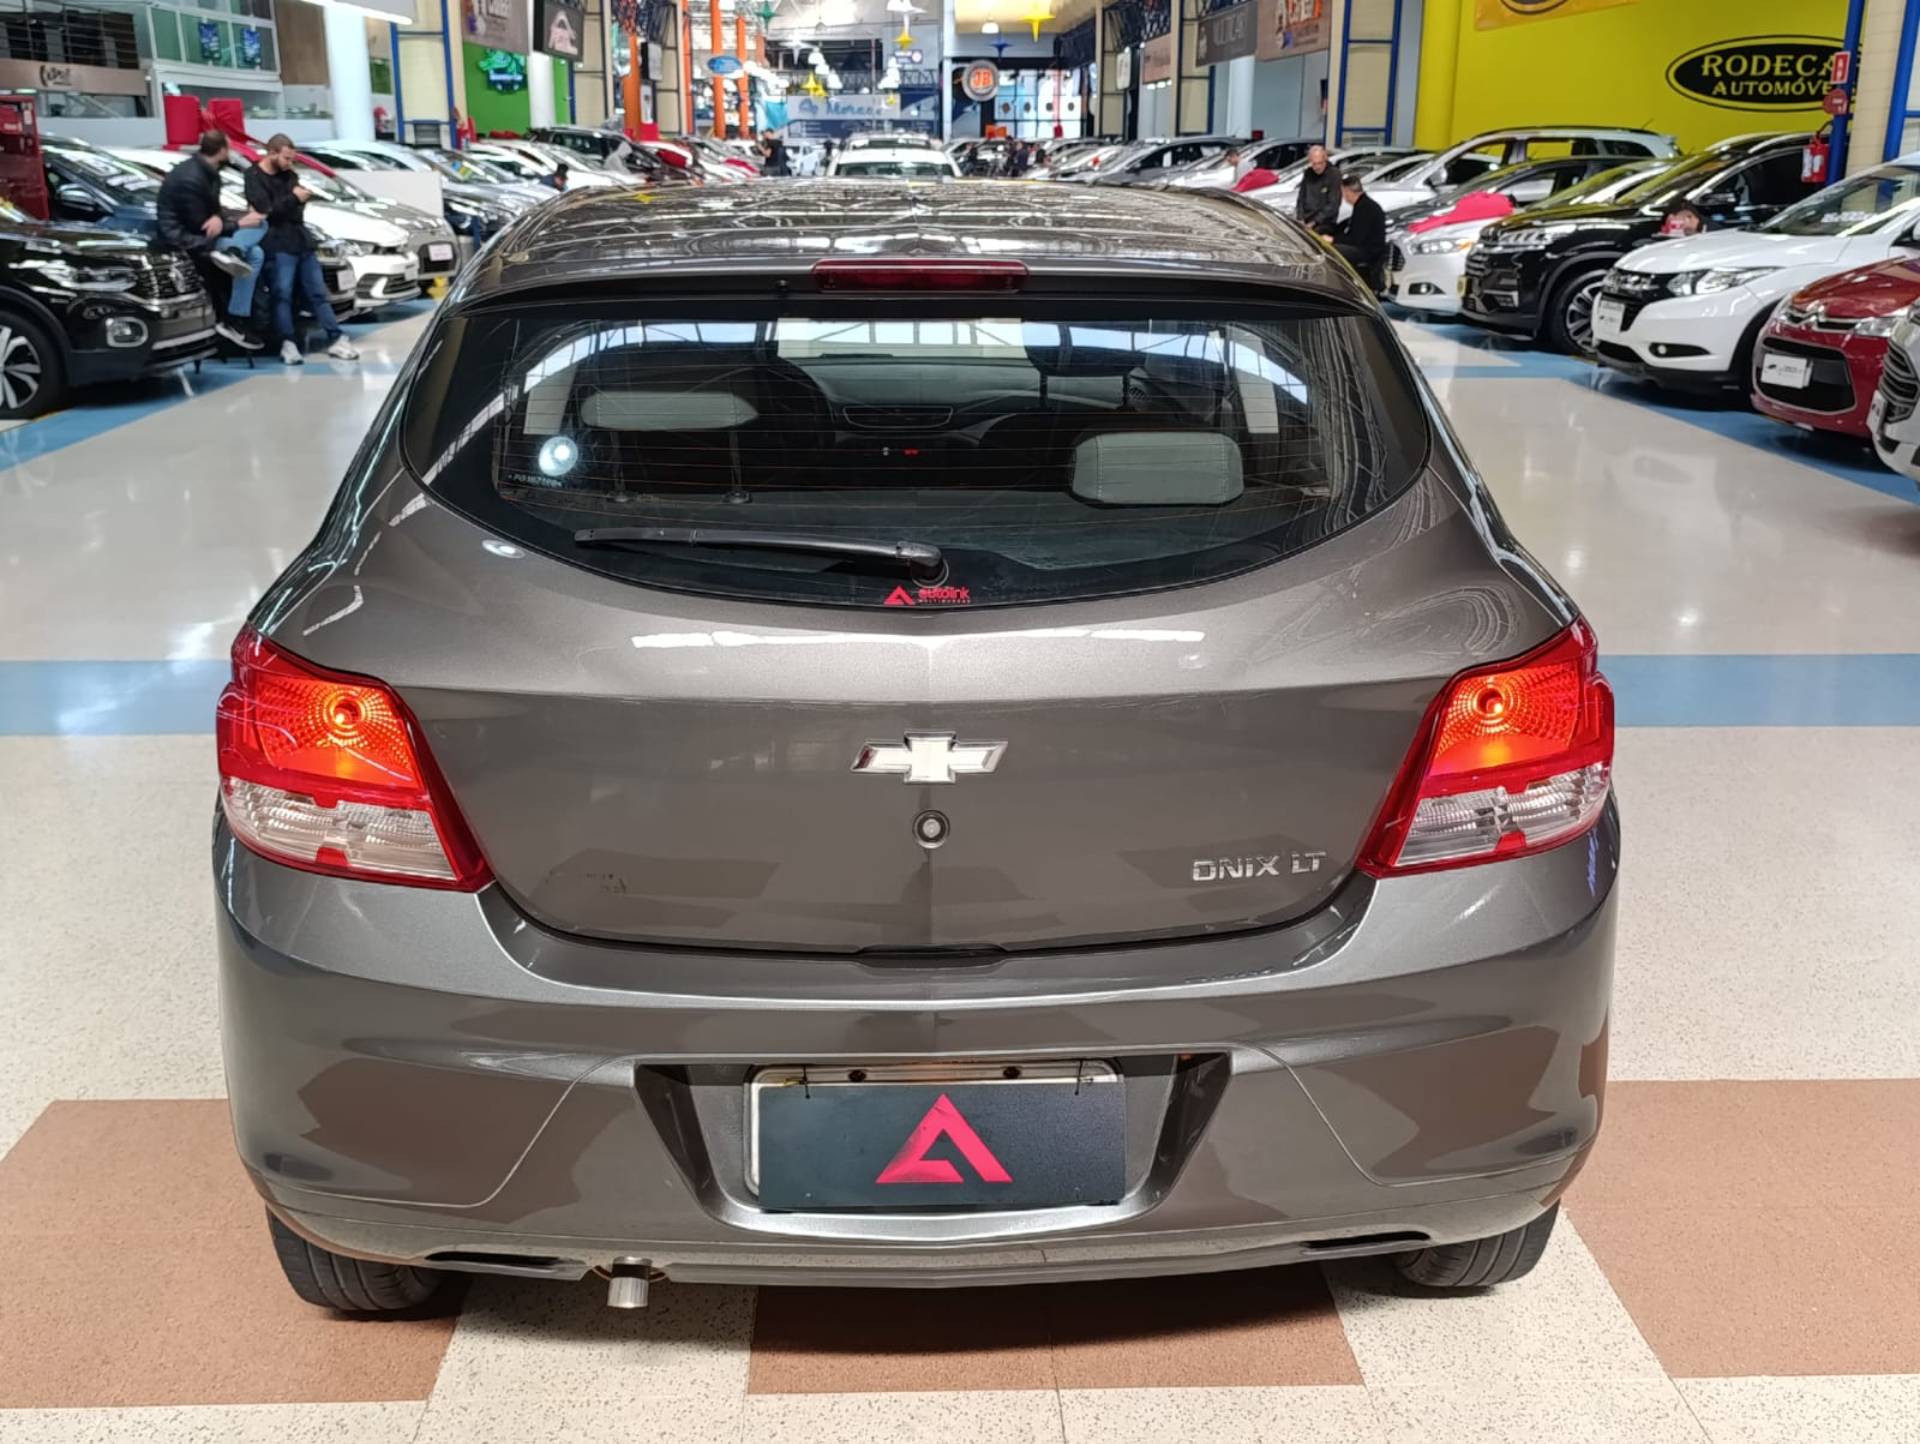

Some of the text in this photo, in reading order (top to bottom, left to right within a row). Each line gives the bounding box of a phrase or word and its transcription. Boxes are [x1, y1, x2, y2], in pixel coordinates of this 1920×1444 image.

[1702, 54, 1835, 77] RODECA
[1712, 77, 1832, 95] AUTOMÓVE
[1192, 851, 1327, 882] ONIX LT
